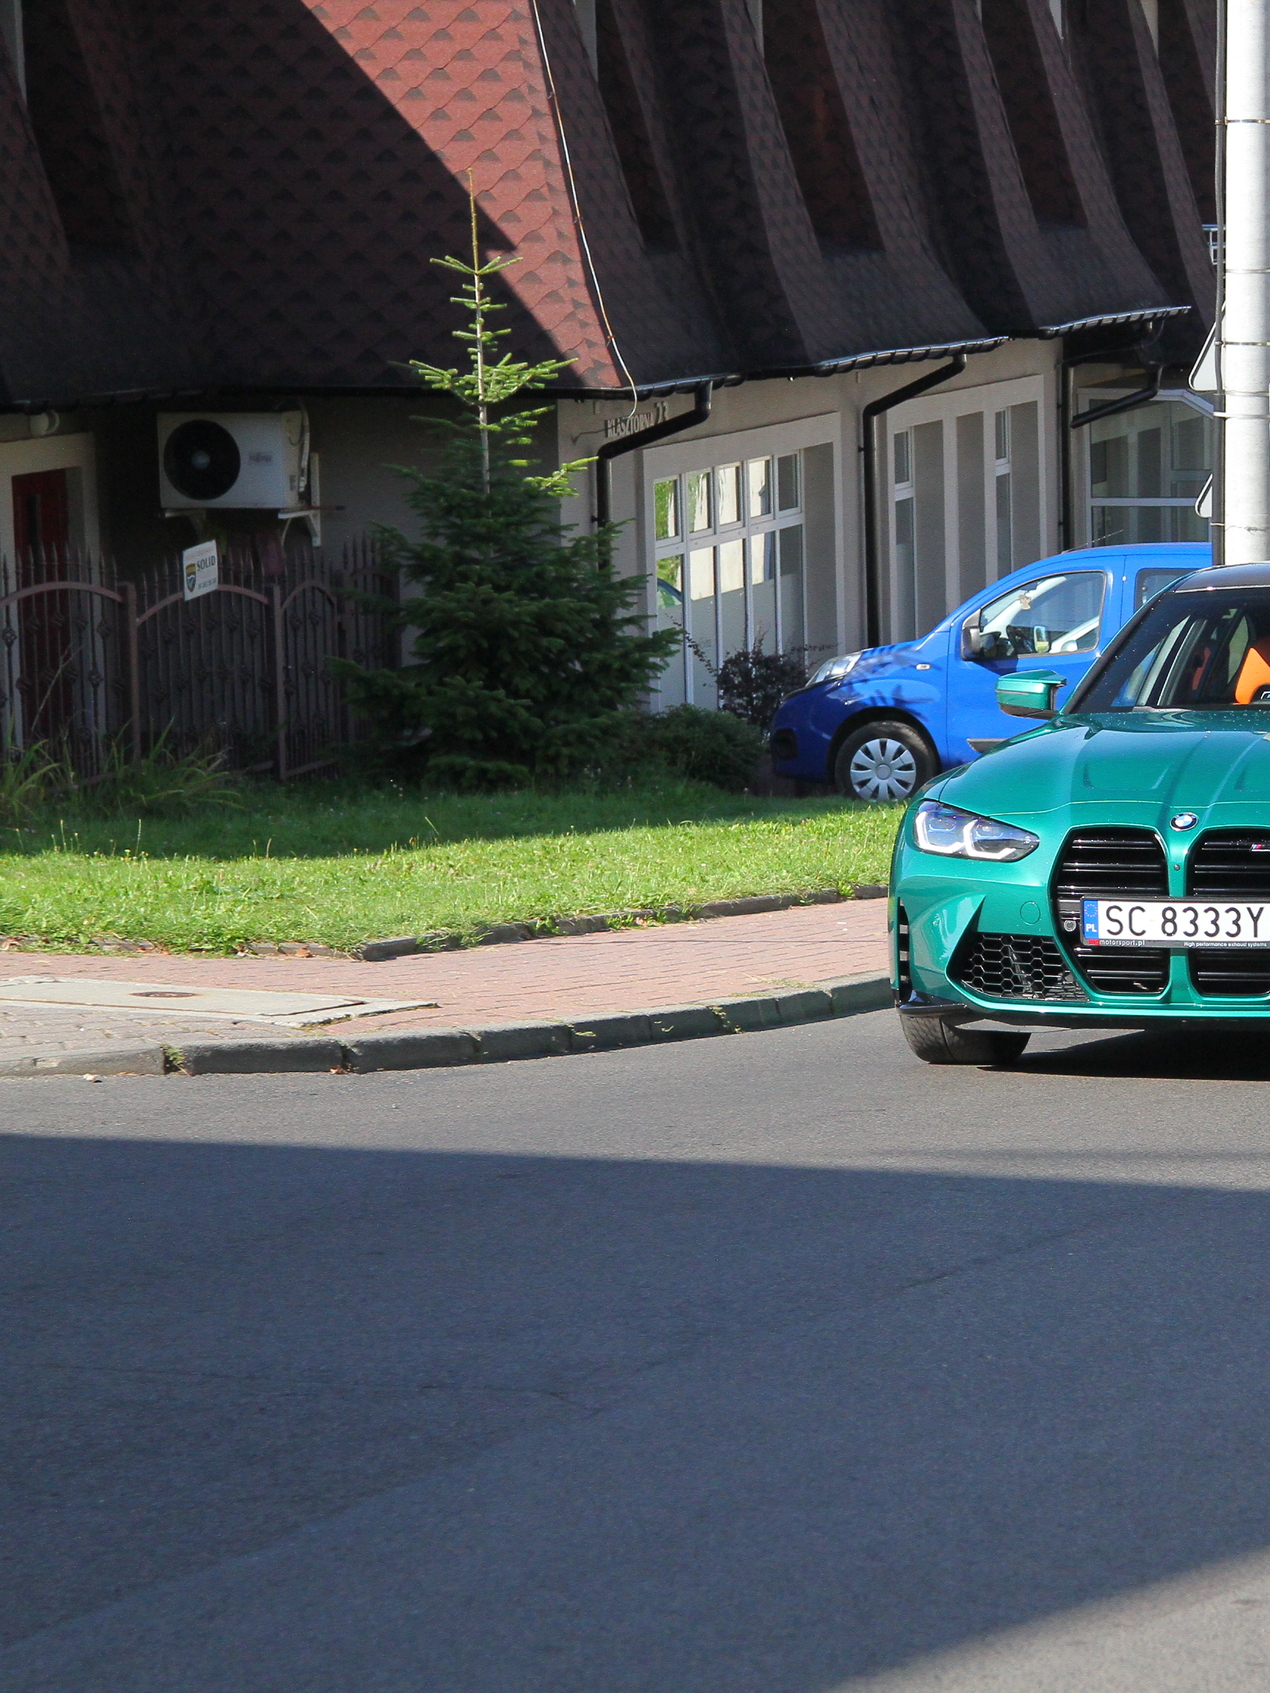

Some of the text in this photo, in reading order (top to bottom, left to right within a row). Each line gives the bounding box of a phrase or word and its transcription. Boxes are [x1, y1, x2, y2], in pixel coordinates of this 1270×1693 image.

[1085, 923, 1098, 933] PL
[1105, 905, 1265, 938] SC 8333Y
